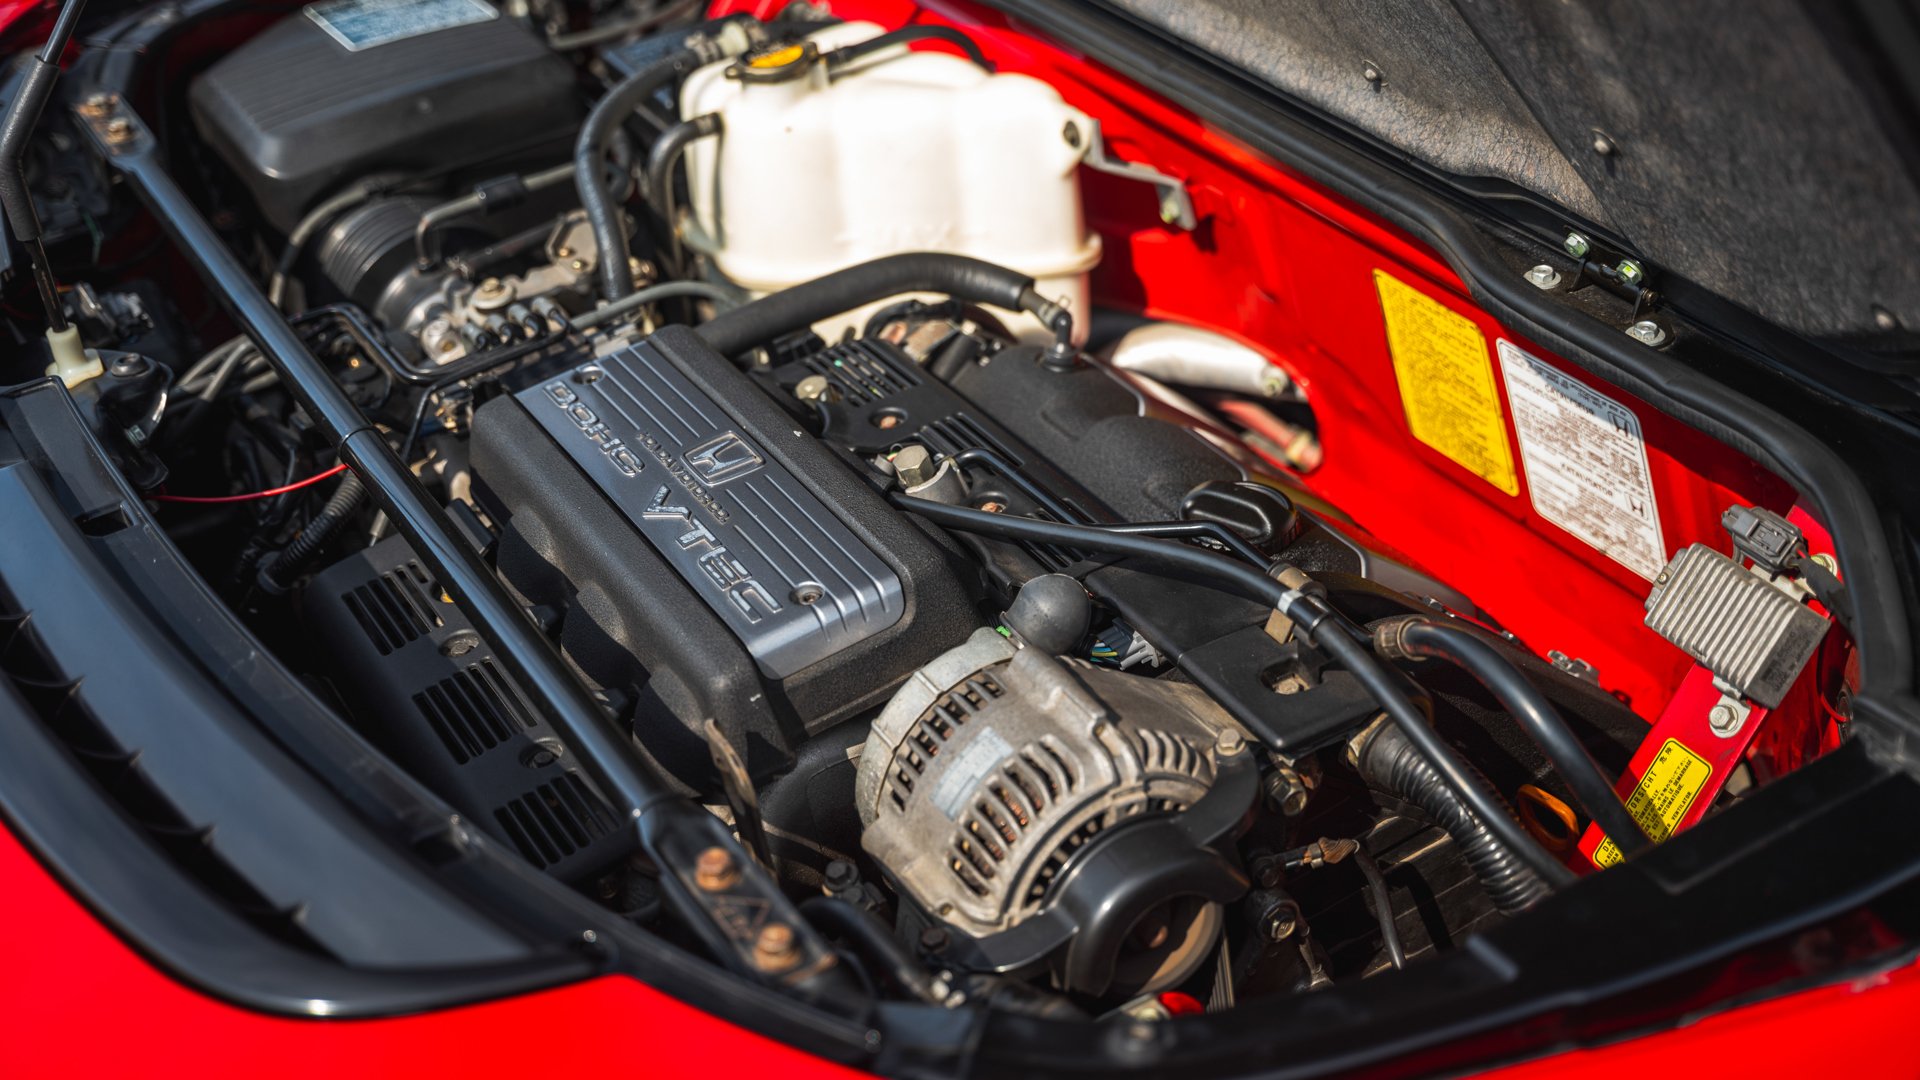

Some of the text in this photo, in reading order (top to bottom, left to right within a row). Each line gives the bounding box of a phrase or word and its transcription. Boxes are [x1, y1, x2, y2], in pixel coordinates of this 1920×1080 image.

[543, 381, 783, 624] DOHC VTEC
[1657, 795, 1669, 811] MAINS
